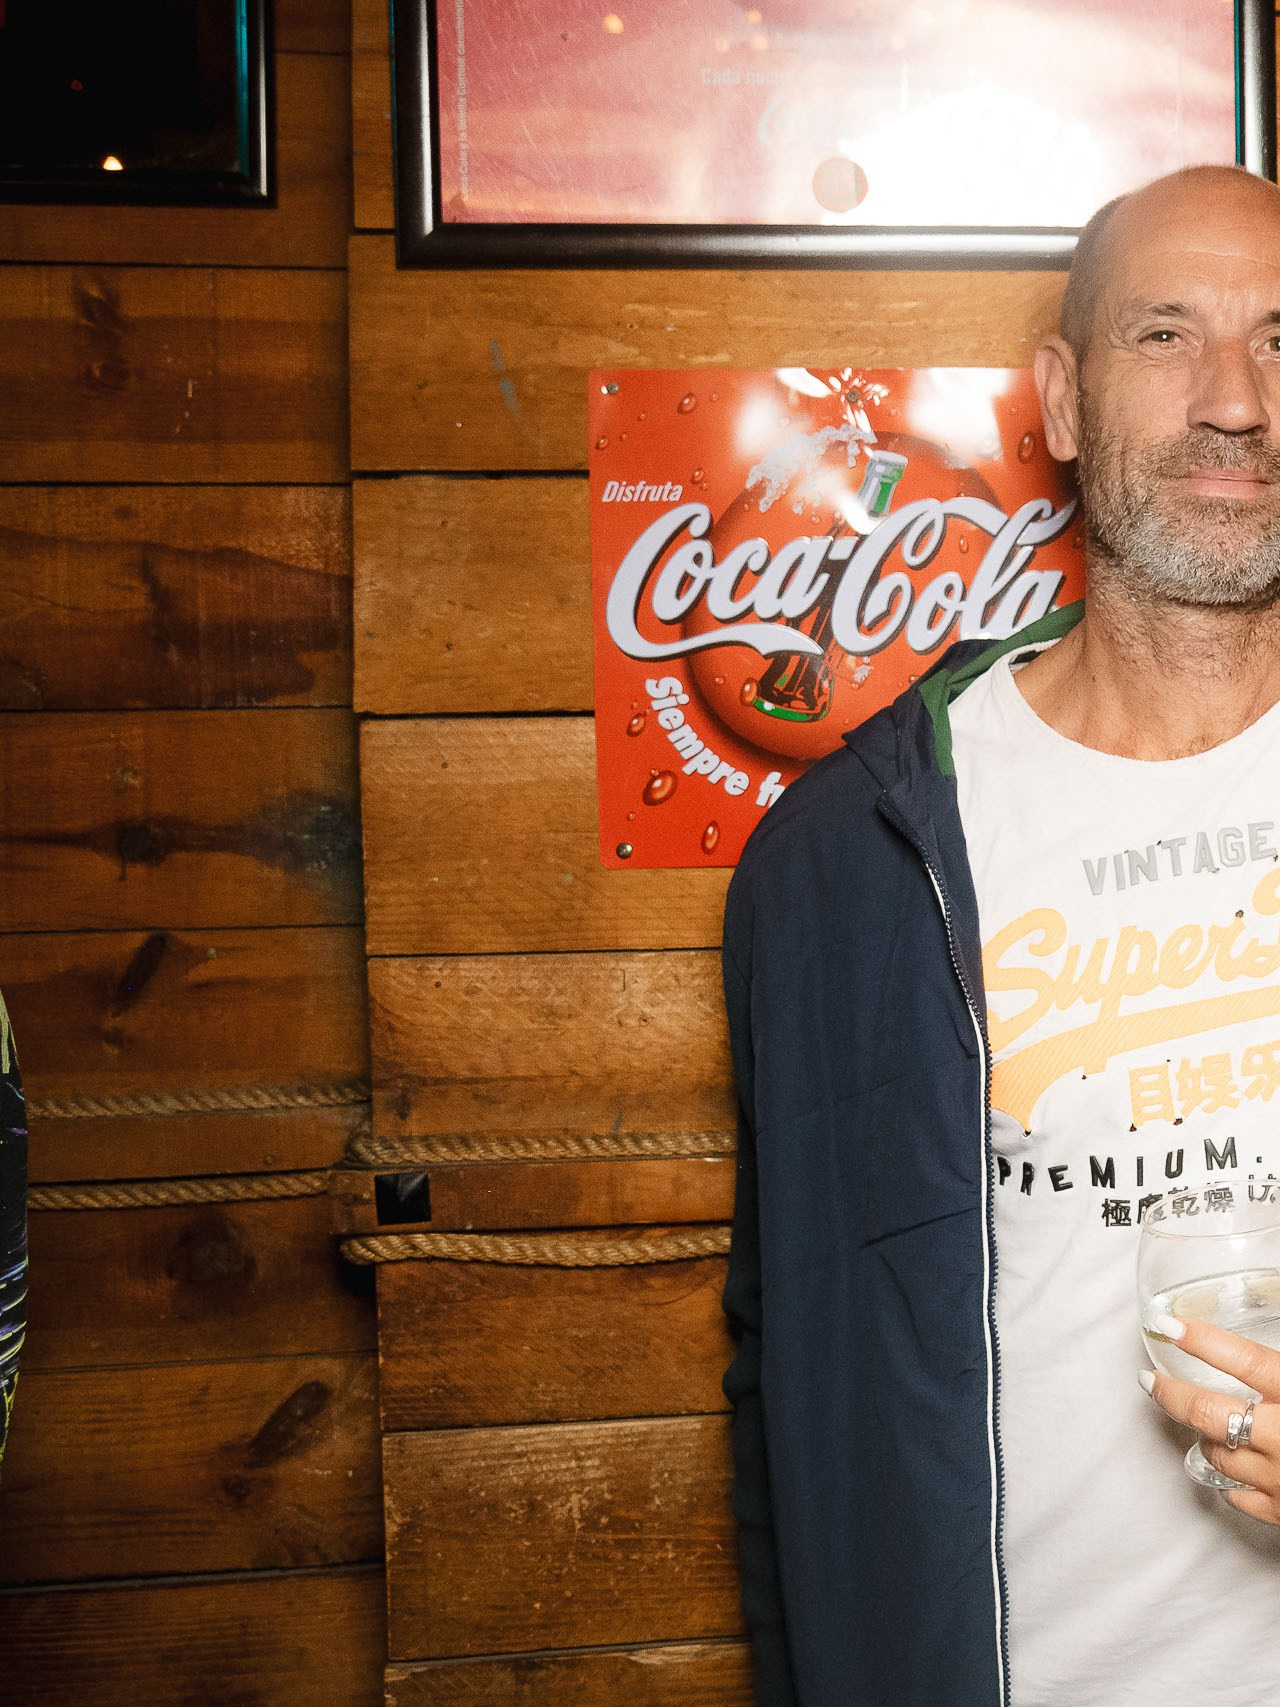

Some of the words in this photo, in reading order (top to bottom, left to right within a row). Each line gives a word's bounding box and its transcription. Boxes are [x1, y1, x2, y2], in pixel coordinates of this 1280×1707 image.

[602, 480, 684, 503] Disfruta
[606, 497, 1078, 661] Coca-Cola
[645, 676, 750, 796] Siempre
[1082, 821, 1278, 896] VINTAGE
